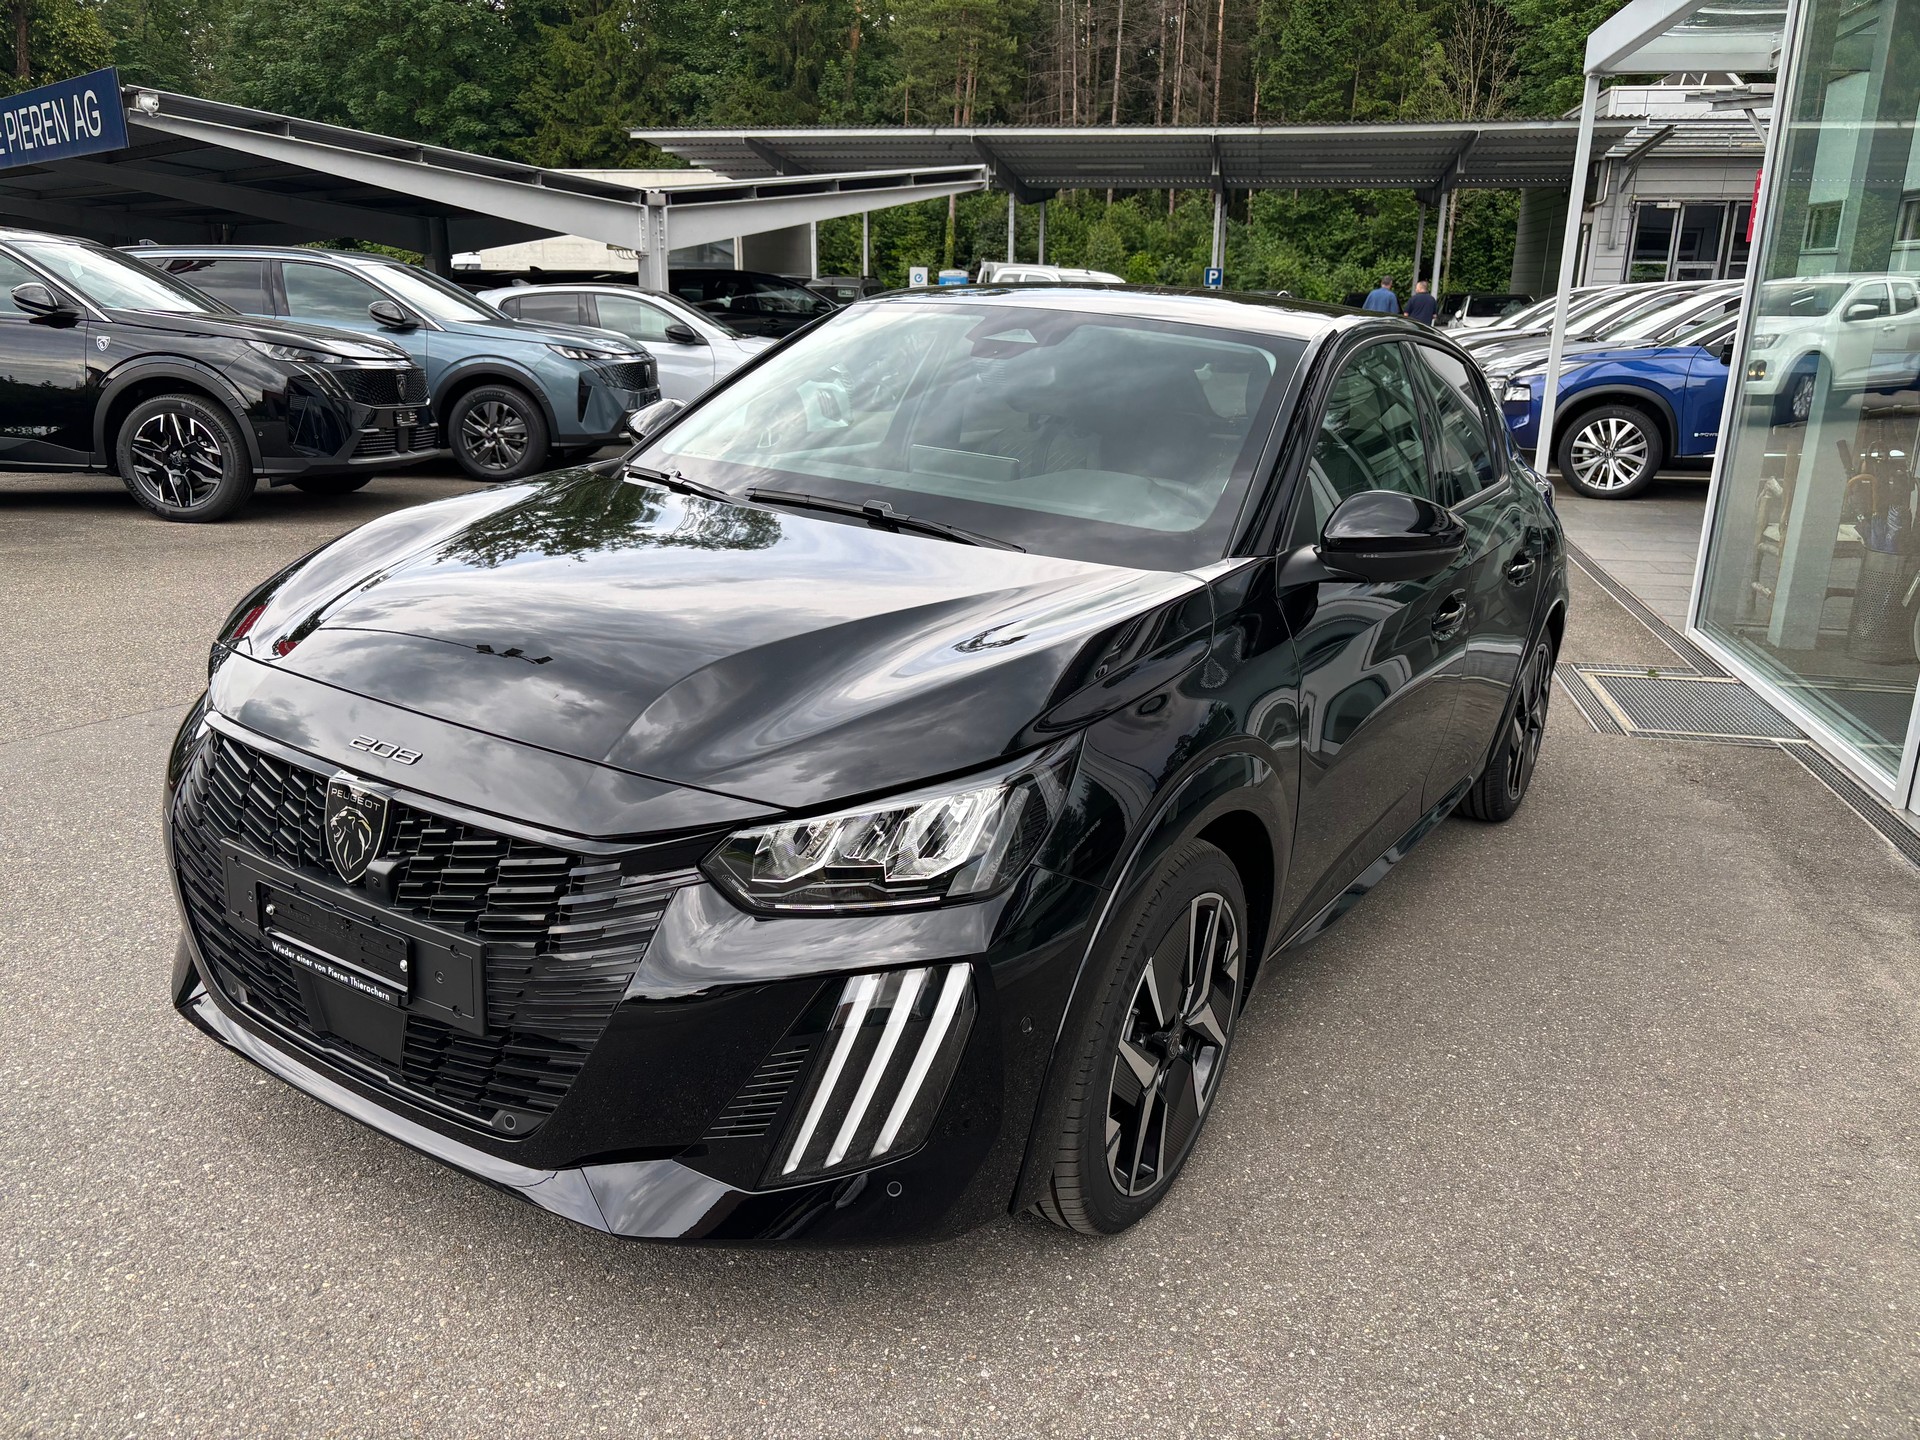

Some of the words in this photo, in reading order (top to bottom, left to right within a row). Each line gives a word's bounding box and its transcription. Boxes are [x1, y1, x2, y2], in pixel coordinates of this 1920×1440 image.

[3, 98, 70, 153] PIEREN
[73, 89, 102, 141] AG
[1209, 270, 1219, 284] P
[349, 734, 424, 766] 208
[331, 787, 381, 811] PEUGEOT
[272, 941, 296, 959] Wieder
[296, 954, 313, 967] einer
[314, 962, 327, 973] von
[328, 966, 349, 983] Pieren
[350, 976, 390, 1001] Thierachern
